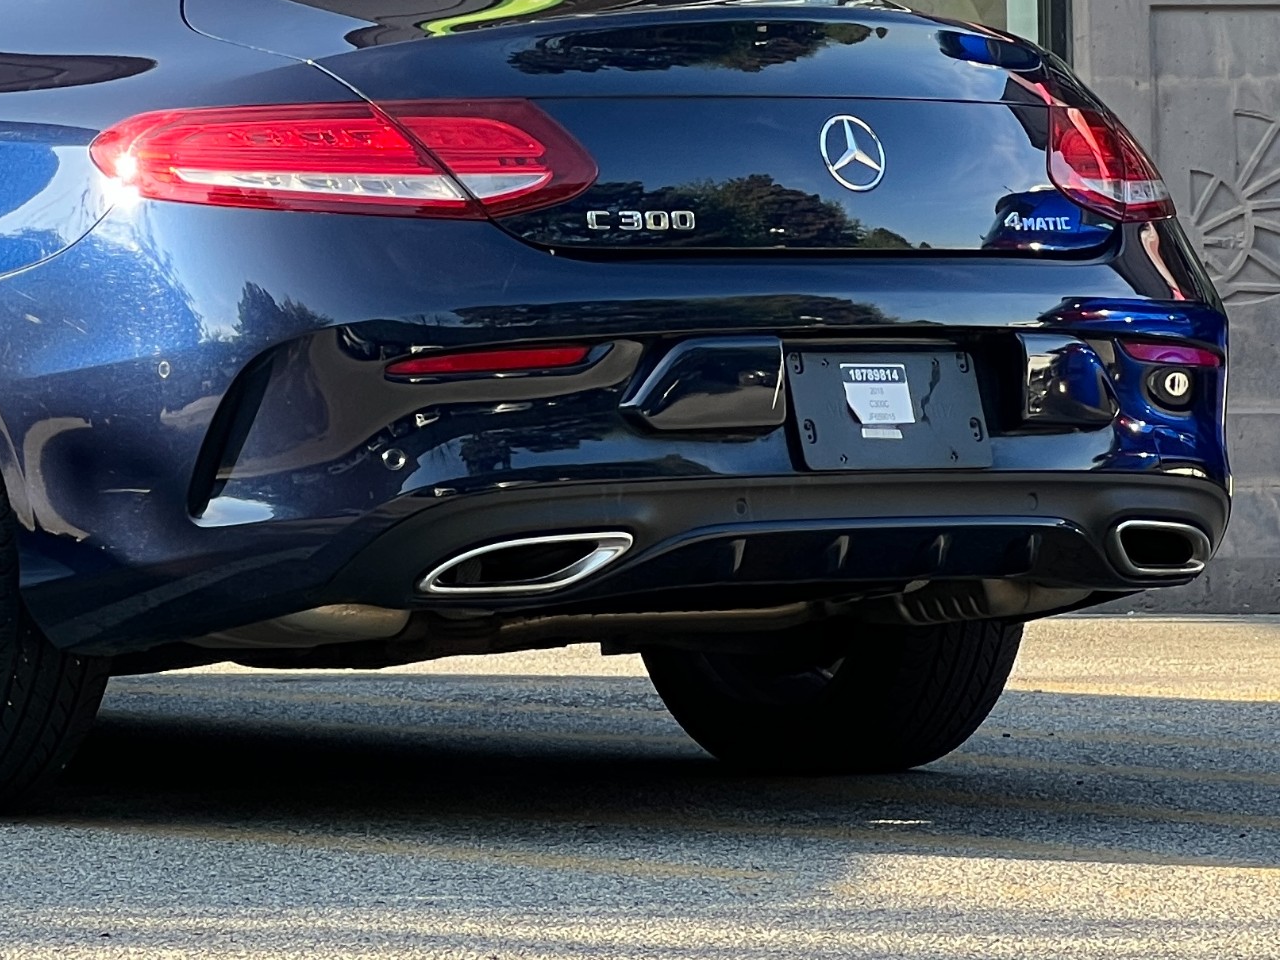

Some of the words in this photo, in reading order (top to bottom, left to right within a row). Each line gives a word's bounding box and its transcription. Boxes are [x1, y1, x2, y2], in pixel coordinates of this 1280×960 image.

[586, 210, 611, 230] C
[618, 210, 695, 230] 300
[1004, 211, 1072, 231] 4MATIC
[848, 368, 899, 381] 18789814
